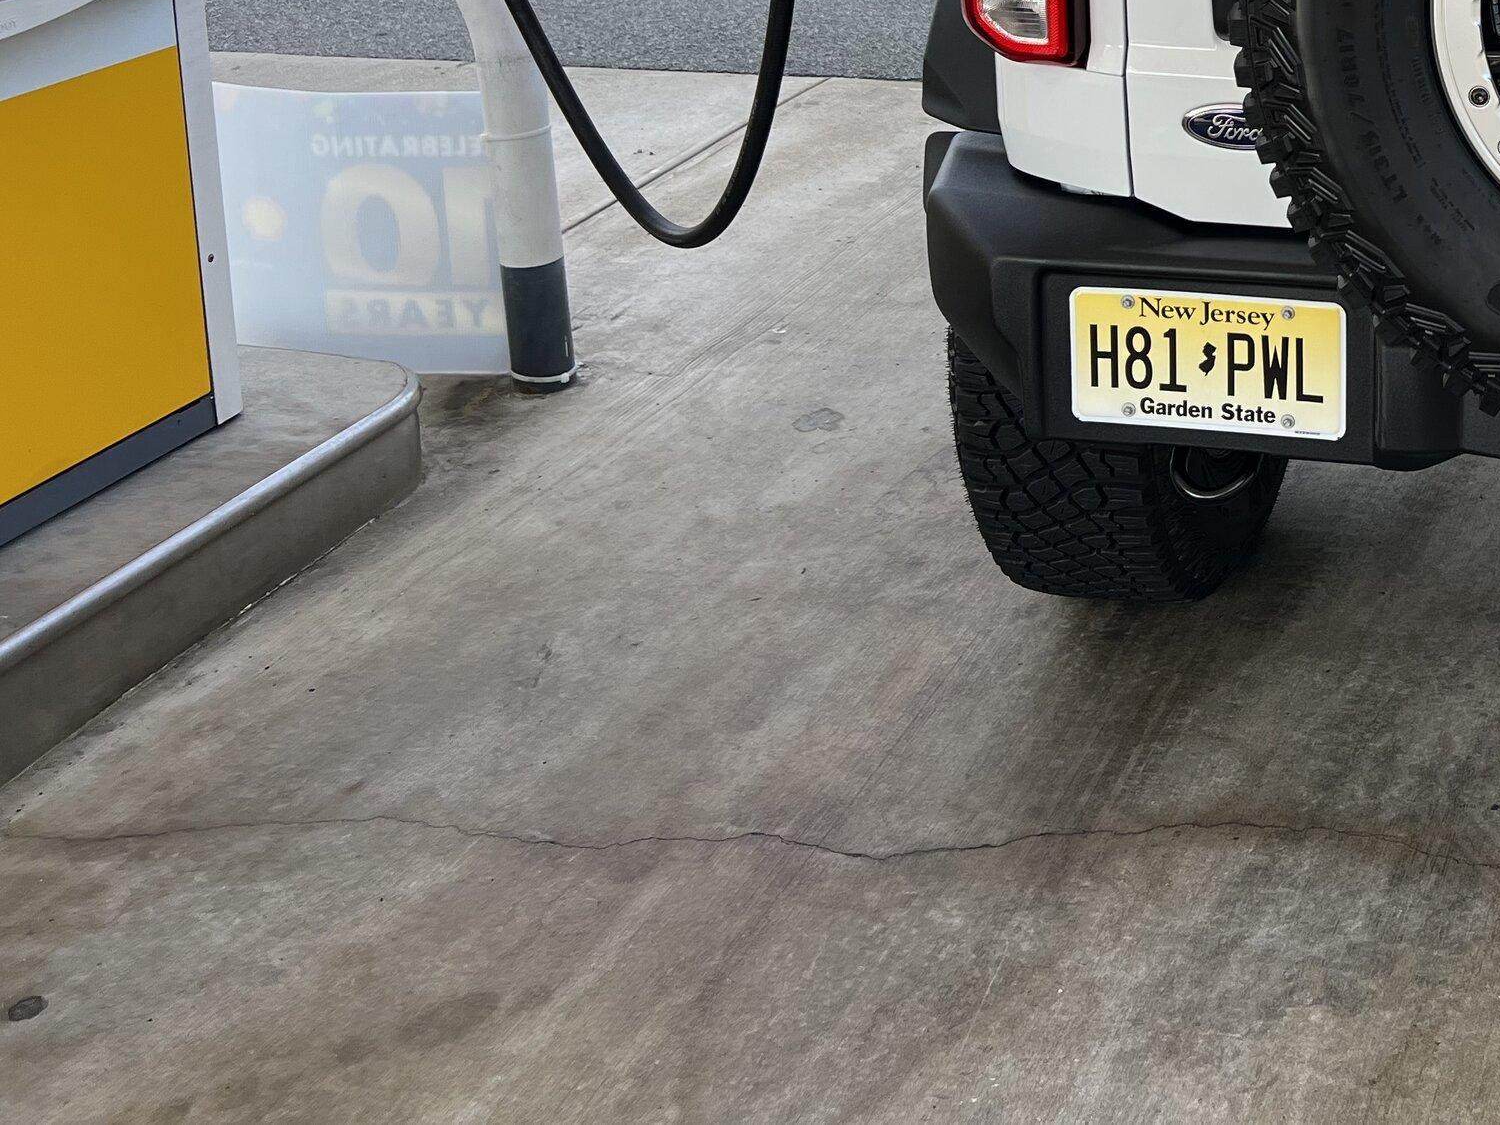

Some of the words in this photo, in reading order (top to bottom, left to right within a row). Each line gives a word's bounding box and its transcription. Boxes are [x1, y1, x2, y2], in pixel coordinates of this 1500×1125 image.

[1138, 296, 1197, 321] New
[1199, 301, 1276, 331] Jersey
[1089, 323, 1188, 393] H81
[1226, 331, 1325, 404] PWL
[1139, 396, 1213, 420] Garden
[1221, 402, 1277, 424] State
